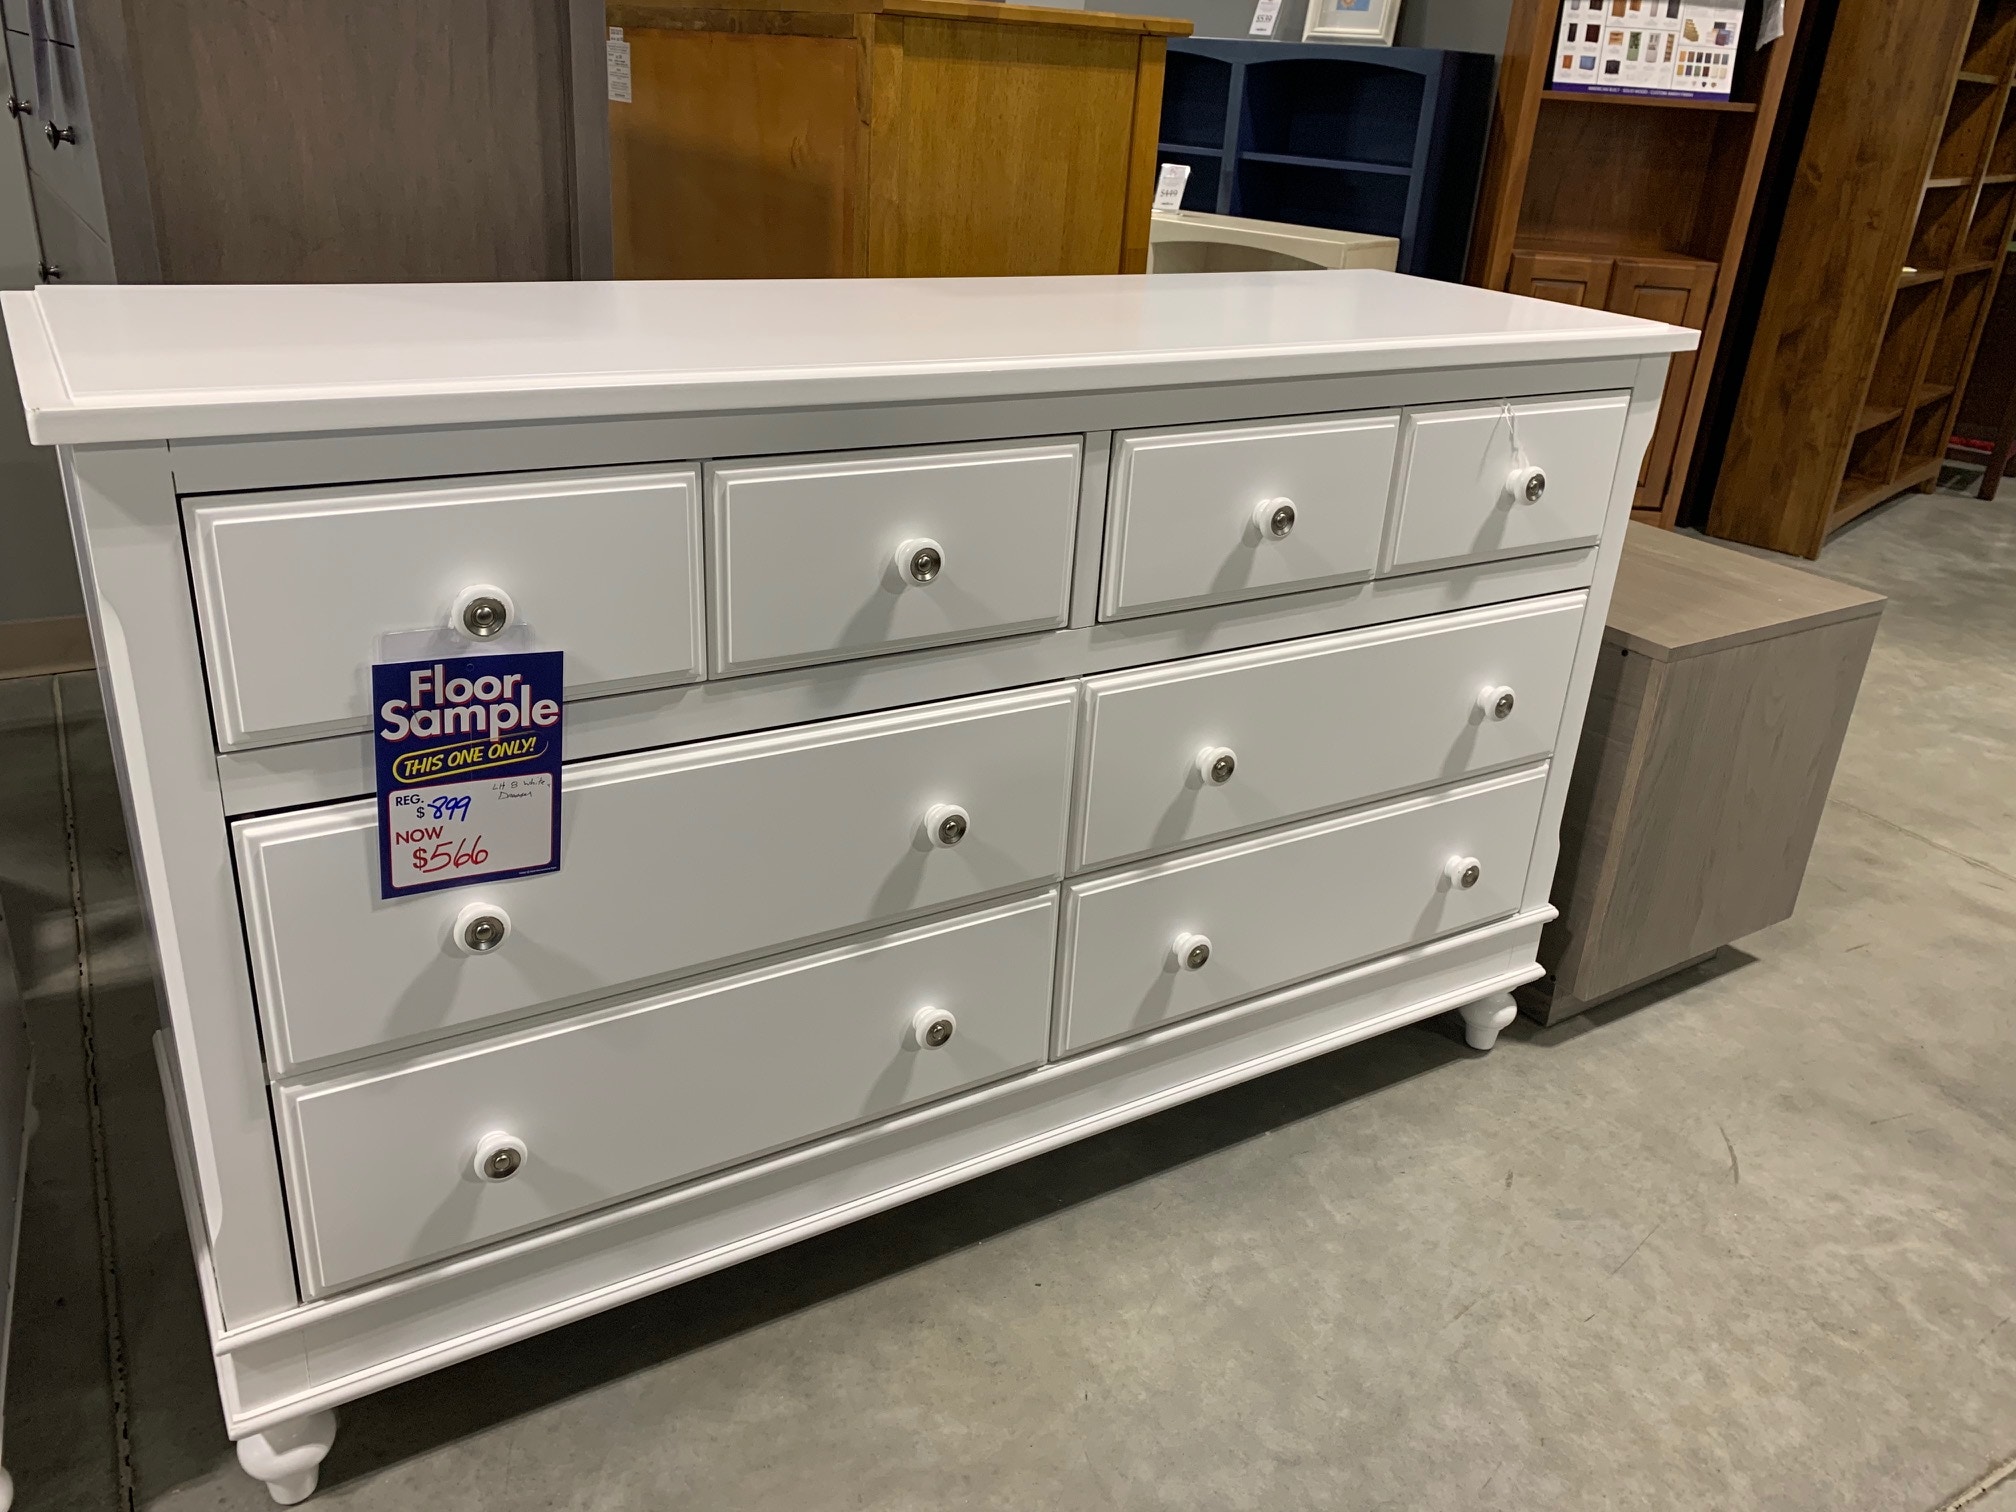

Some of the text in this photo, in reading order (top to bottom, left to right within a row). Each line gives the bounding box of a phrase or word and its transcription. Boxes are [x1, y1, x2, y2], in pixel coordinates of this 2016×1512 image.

[410, 663, 522, 707] Floor
[380, 685, 560, 742] Sample
[404, 737, 536, 776] THIS ONE ONLY!
[395, 794, 424, 807] REG.
[395, 825, 444, 845] NOW
[412, 835, 489, 873] $566
